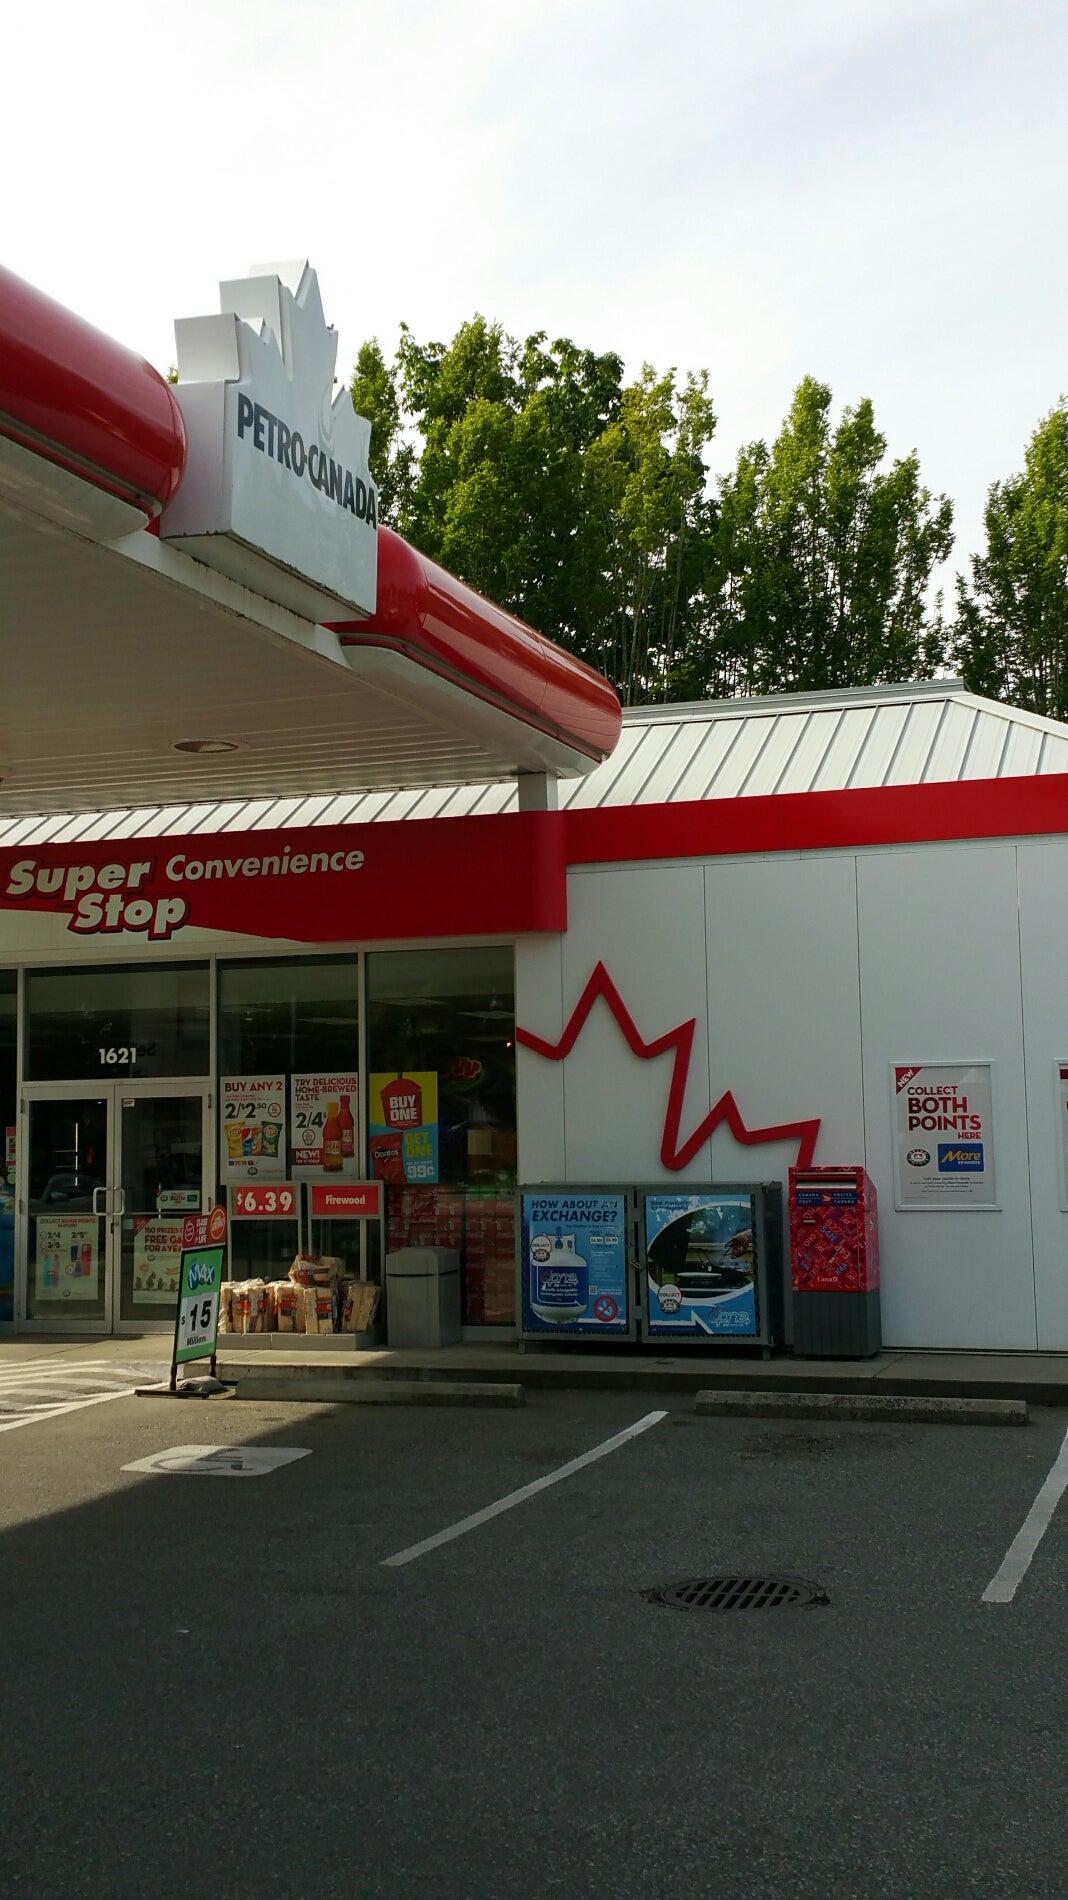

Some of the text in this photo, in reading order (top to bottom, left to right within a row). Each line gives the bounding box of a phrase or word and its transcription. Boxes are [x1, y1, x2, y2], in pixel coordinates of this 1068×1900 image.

[166, 845, 365, 881] Convenience
[6, 860, 151, 900] Super
[73, 893, 186, 934] Stop
[99, 1047, 137, 1064] 1621
[295, 1077, 357, 1087] TRY DELICIOUS
[897, 1069, 915, 1088] NEW
[225, 1081, 283, 1092] BUY ANY 2
[295, 1085, 357, 1094] HOME-BREWED
[907, 1086, 958, 1096] COLLECT
[295, 1093, 320, 1101] TASTE
[389, 1095, 416, 1109] BUY
[907, 1097, 968, 1114] BOTH
[390, 1108, 418, 1121] ONE
[908, 1114, 982, 1131] POINTS
[957, 1132, 982, 1140] HERE
[295, 1149, 321, 1159] NEW!
[374, 1150, 400, 1159] Doritos
[941, 1150, 981, 1162] More
[237, 1191, 293, 1212] $6.39
[325, 1194, 367, 1206] Firewood
[531, 1200, 559, 1209] HOW
[561, 1200, 599, 1209] ABOUT
[531, 1209, 618, 1223] EXCHANGE?
[144, 1234, 167, 1244] FREE
[144, 1244, 161, 1252] FOR
[190, 1299, 211, 1332] 15
[186, 1336, 207, 1347] Million
